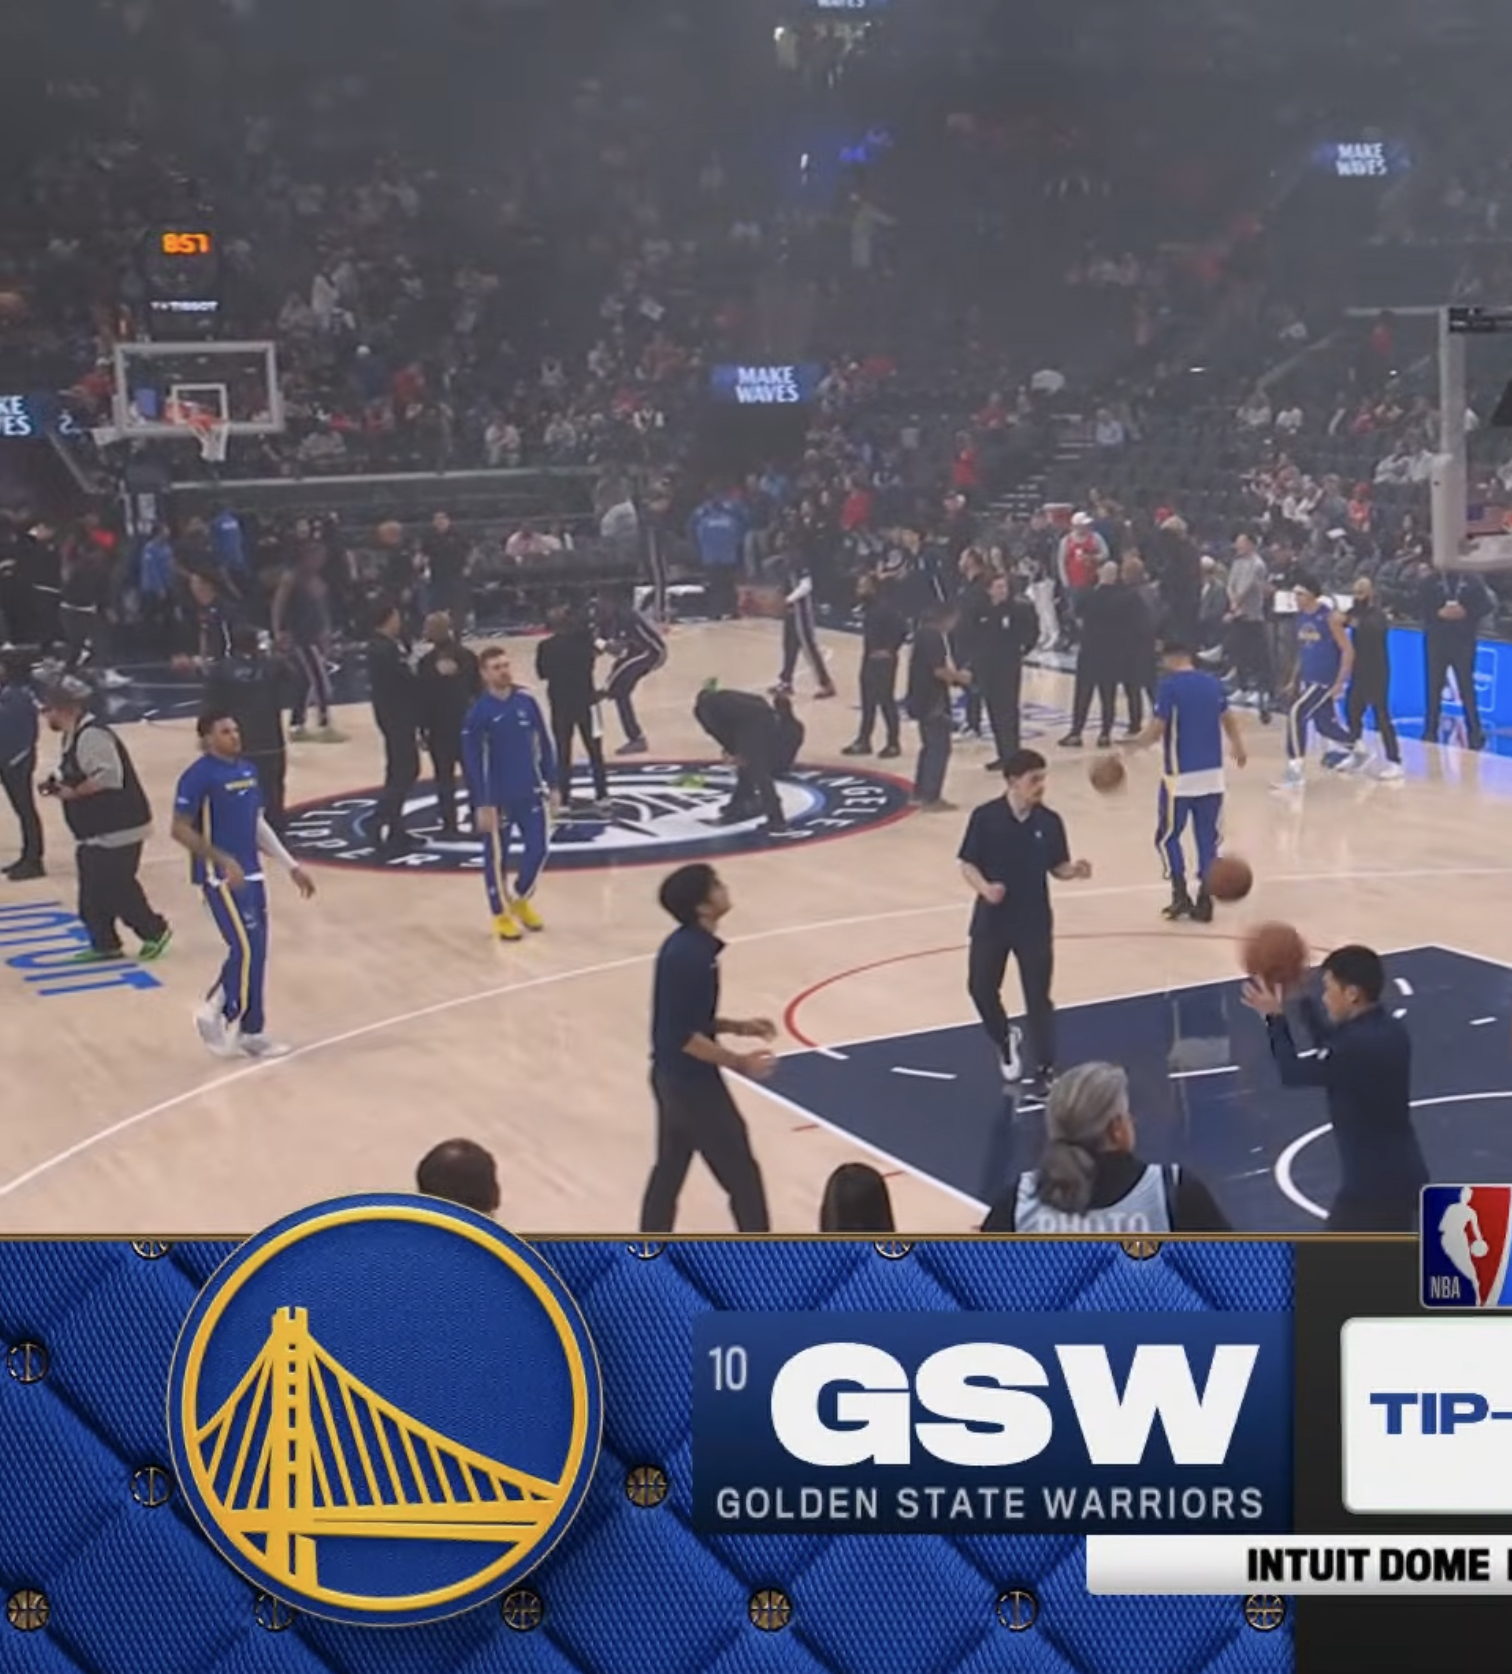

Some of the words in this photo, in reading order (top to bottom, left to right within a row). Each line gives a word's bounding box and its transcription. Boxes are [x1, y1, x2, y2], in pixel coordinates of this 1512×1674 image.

[1337, 142, 1384, 159] MAKE
[1336, 158, 1388, 175] WAVES
[738, 365, 795, 384] MAKE
[735, 383, 800, 403] WAVES
[1037, 1210, 1149, 1233] PHOTO
